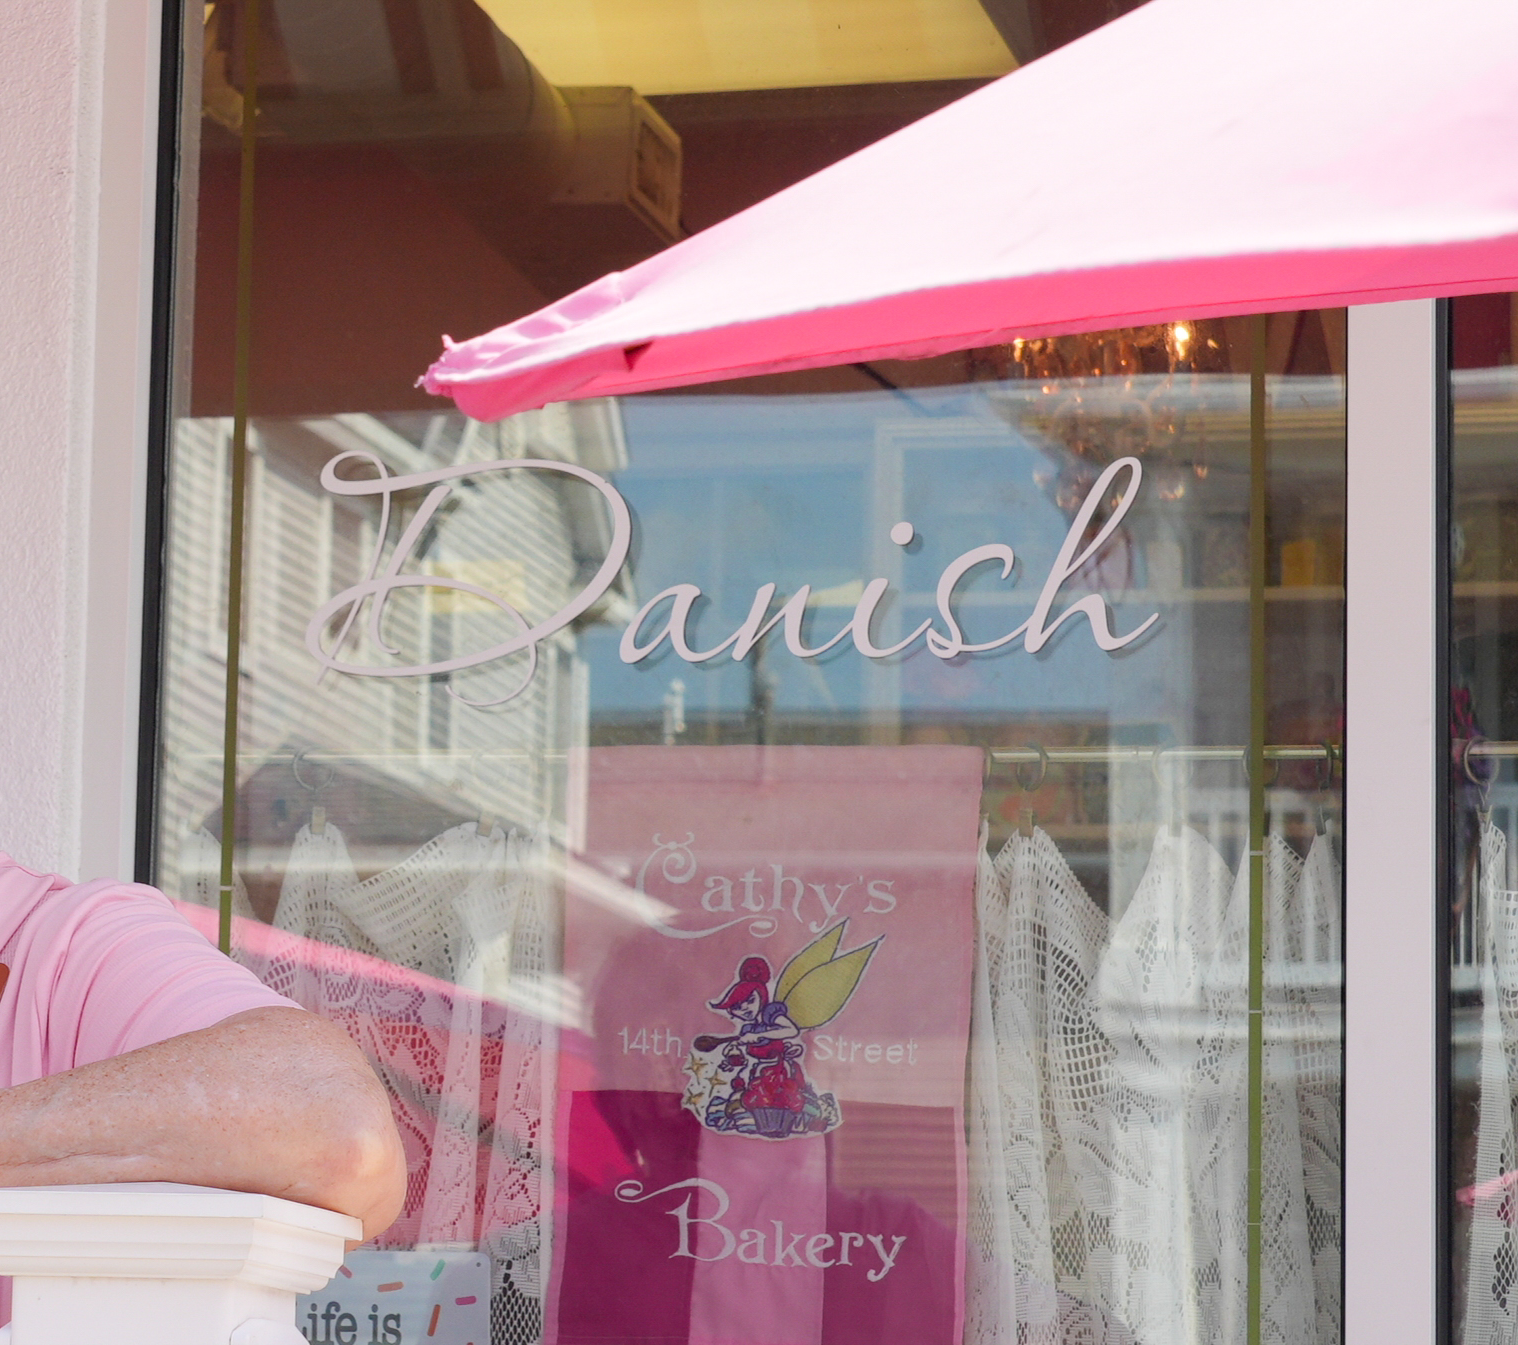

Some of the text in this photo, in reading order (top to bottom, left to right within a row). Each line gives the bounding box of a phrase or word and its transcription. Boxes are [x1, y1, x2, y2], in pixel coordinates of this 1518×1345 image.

[305, 449, 1159, 707] Danish
[634, 831, 897, 939] Cathy's
[813, 1034, 919, 1066] Street
[614, 1177, 908, 1283] Bakery
